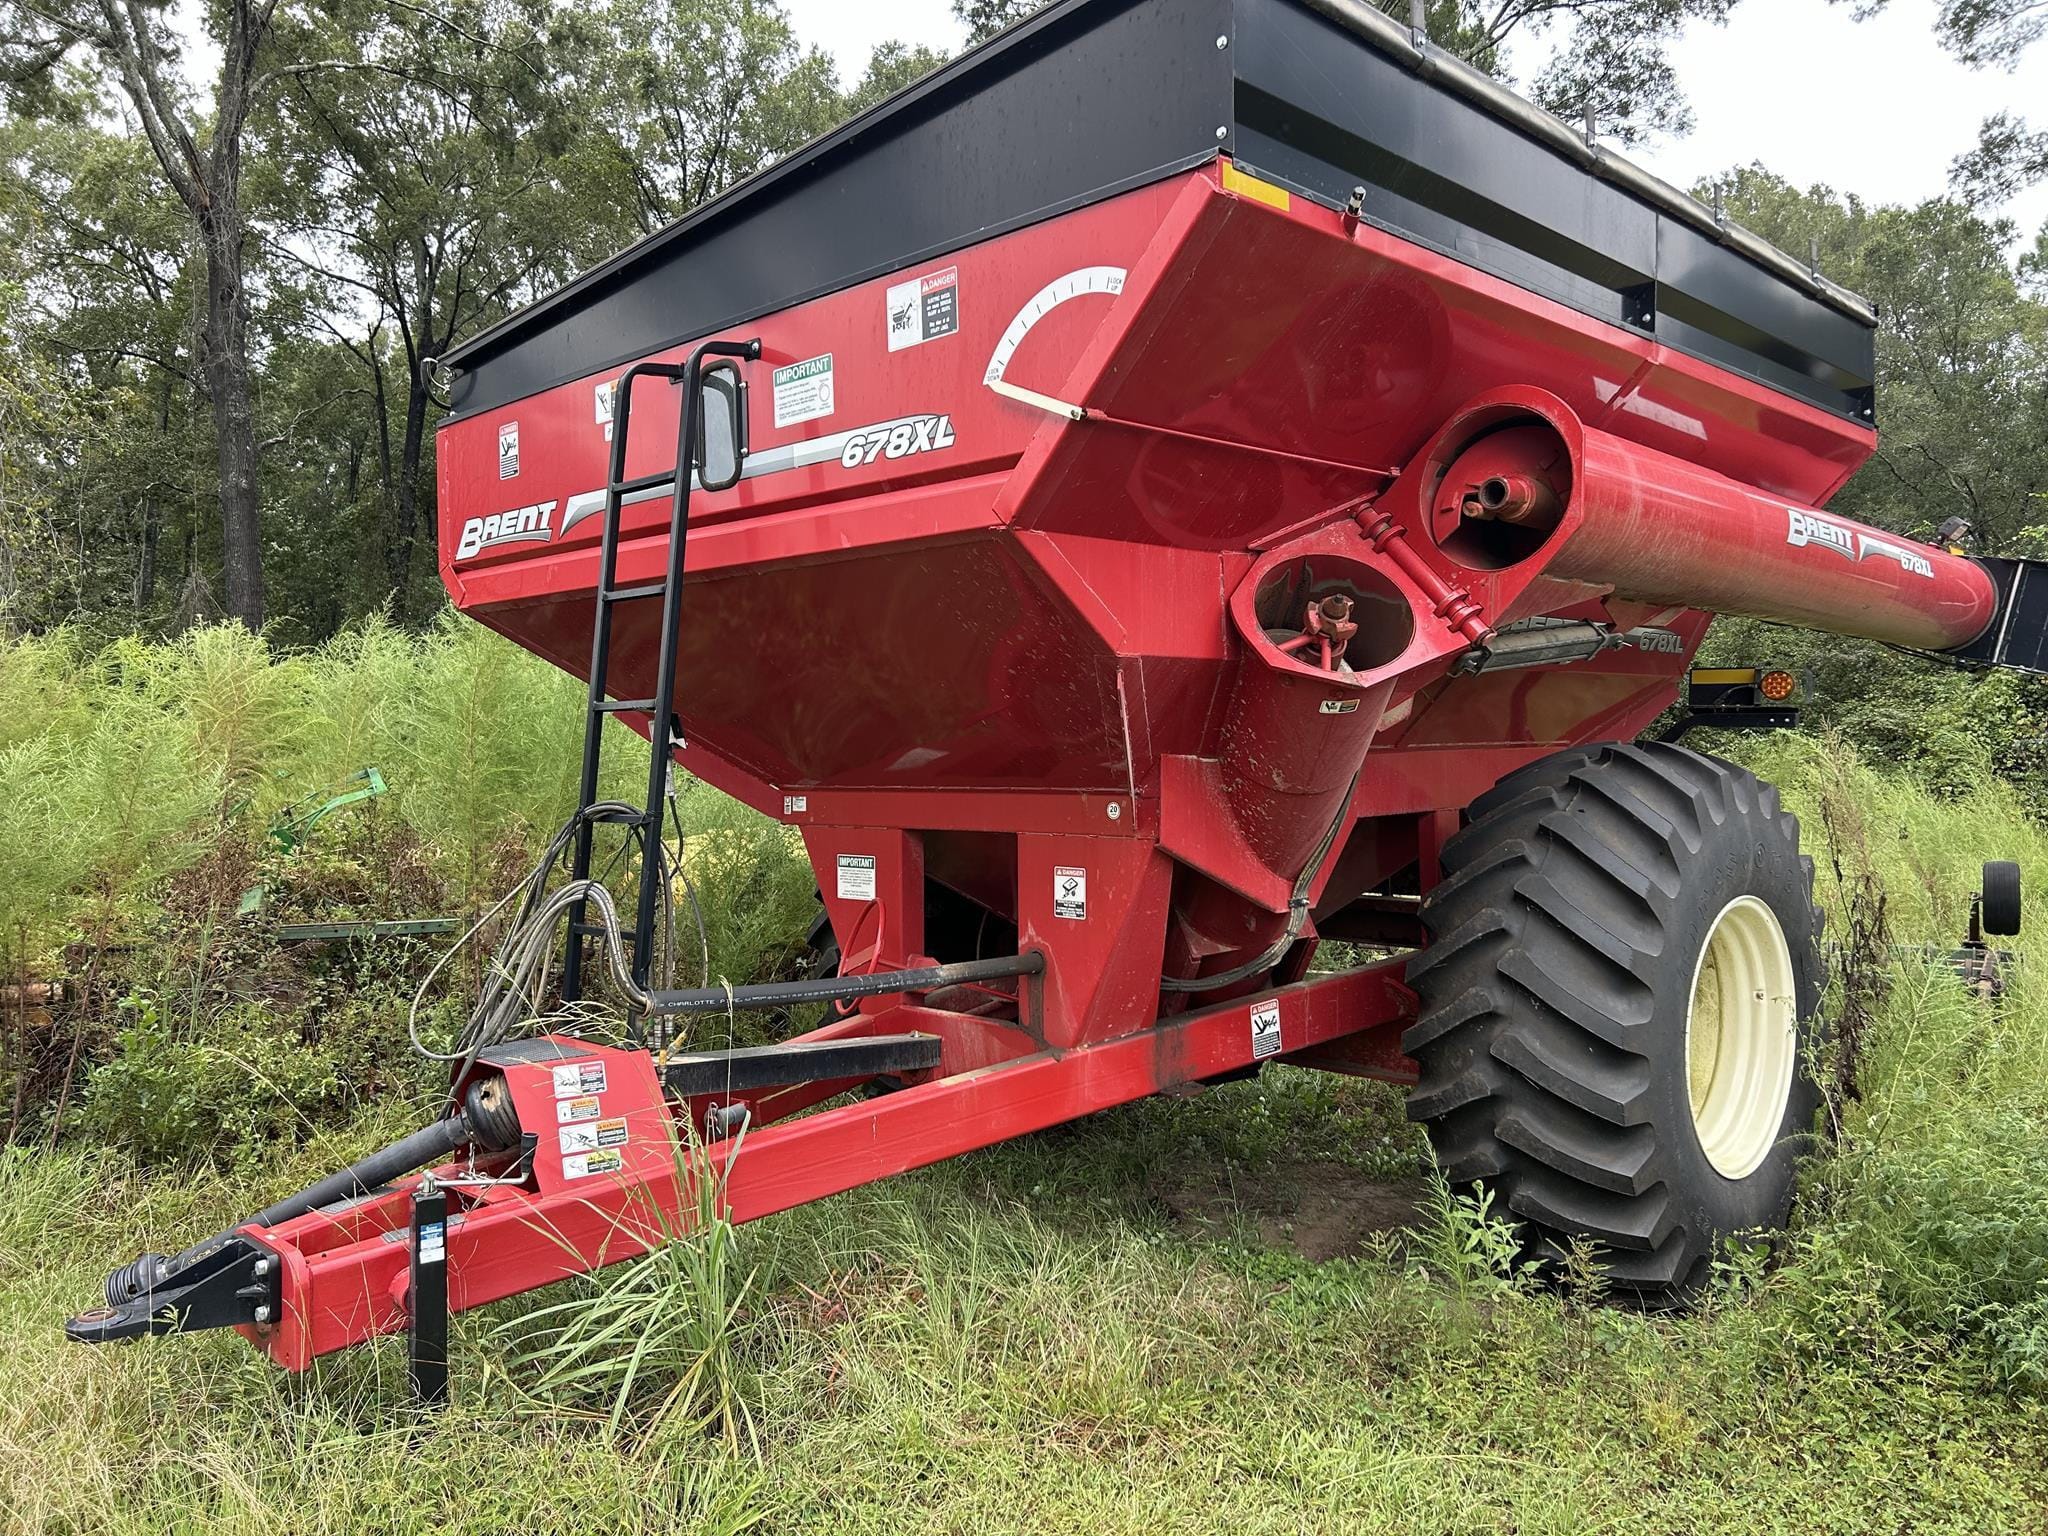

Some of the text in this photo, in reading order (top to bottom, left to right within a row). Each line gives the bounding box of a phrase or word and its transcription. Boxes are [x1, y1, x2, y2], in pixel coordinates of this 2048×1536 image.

[929, 272, 955, 289] DANGER
[1110, 277, 1122, 285] LOCK
[776, 358, 829, 385] IMPORTANT
[841, 415, 956, 469] 678XL
[455, 499, 559, 561] BRENT
[1786, 509, 1854, 551] BRENT
[1900, 553, 1935, 579] 678XL
[1640, 632, 1684, 654] 678XL
[1110, 805, 1118, 813] 20
[839, 857, 874, 868] IMPORTANT
[668, 999, 716, 1007] CHARLOTTE
[1258, 1001, 1277, 1012] DANGER
